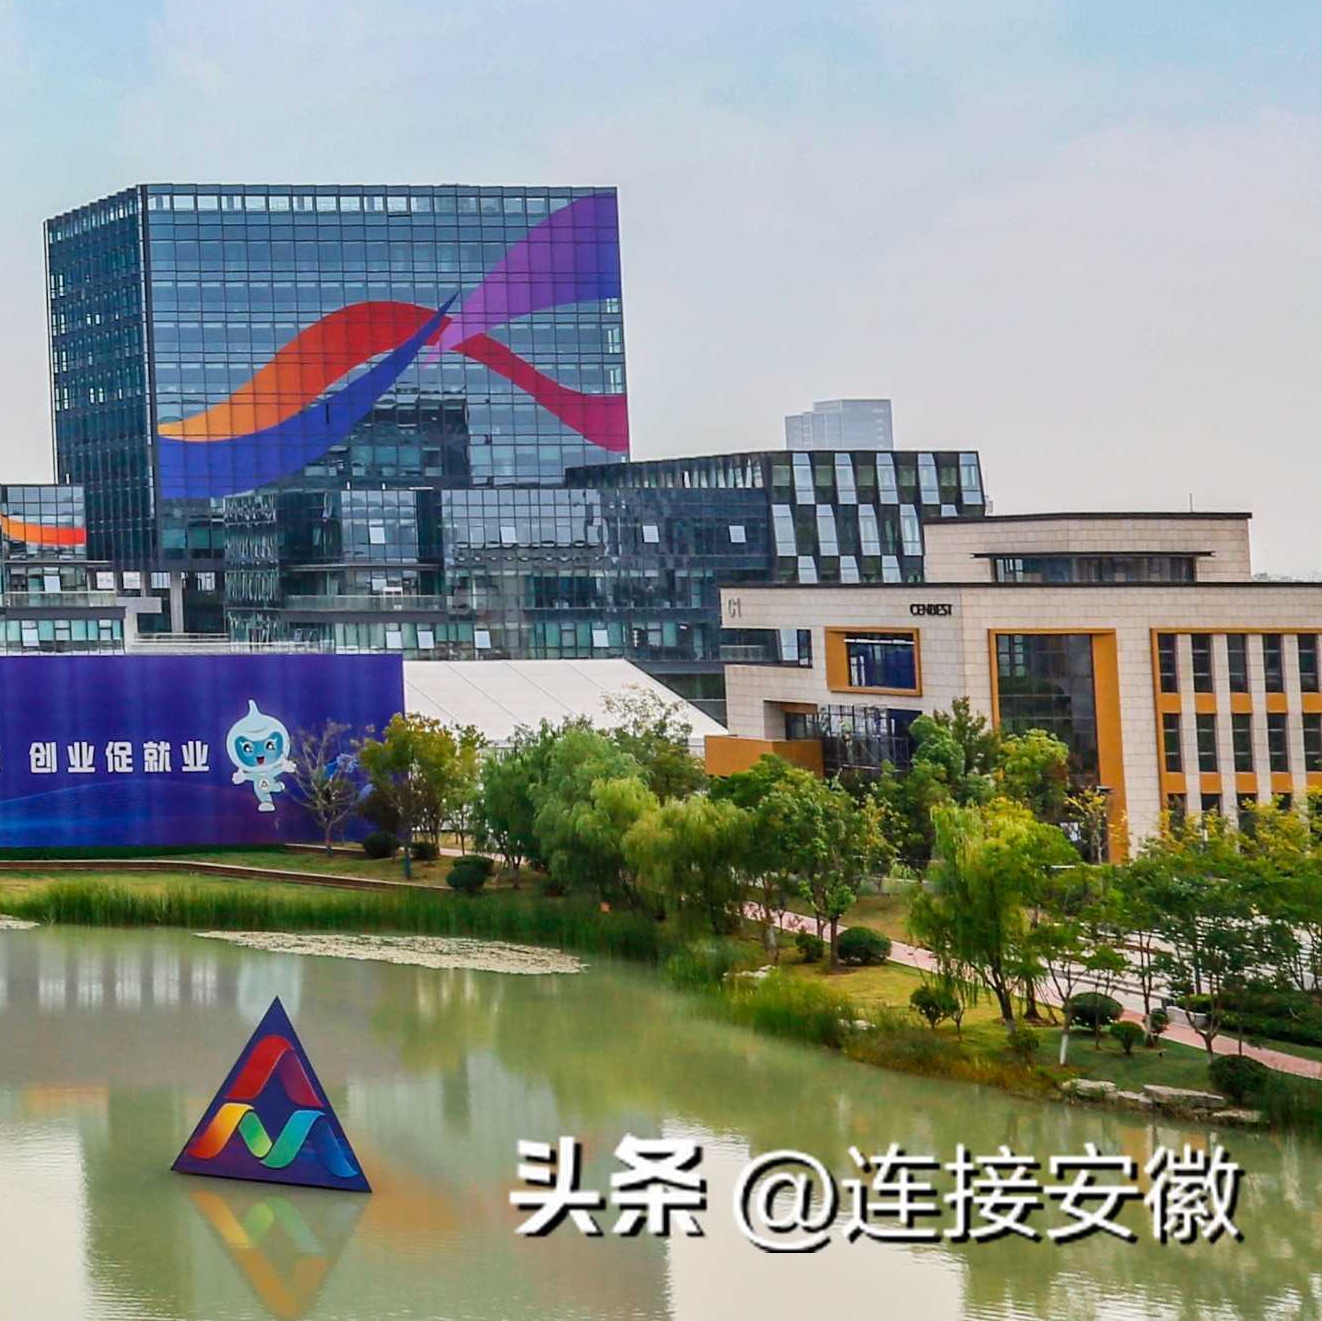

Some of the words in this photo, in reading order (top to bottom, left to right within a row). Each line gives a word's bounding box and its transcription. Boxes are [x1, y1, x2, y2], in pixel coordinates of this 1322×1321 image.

[910, 603, 953, 616] CENBEST
[28, 739, 211, 774] 创业促就业
